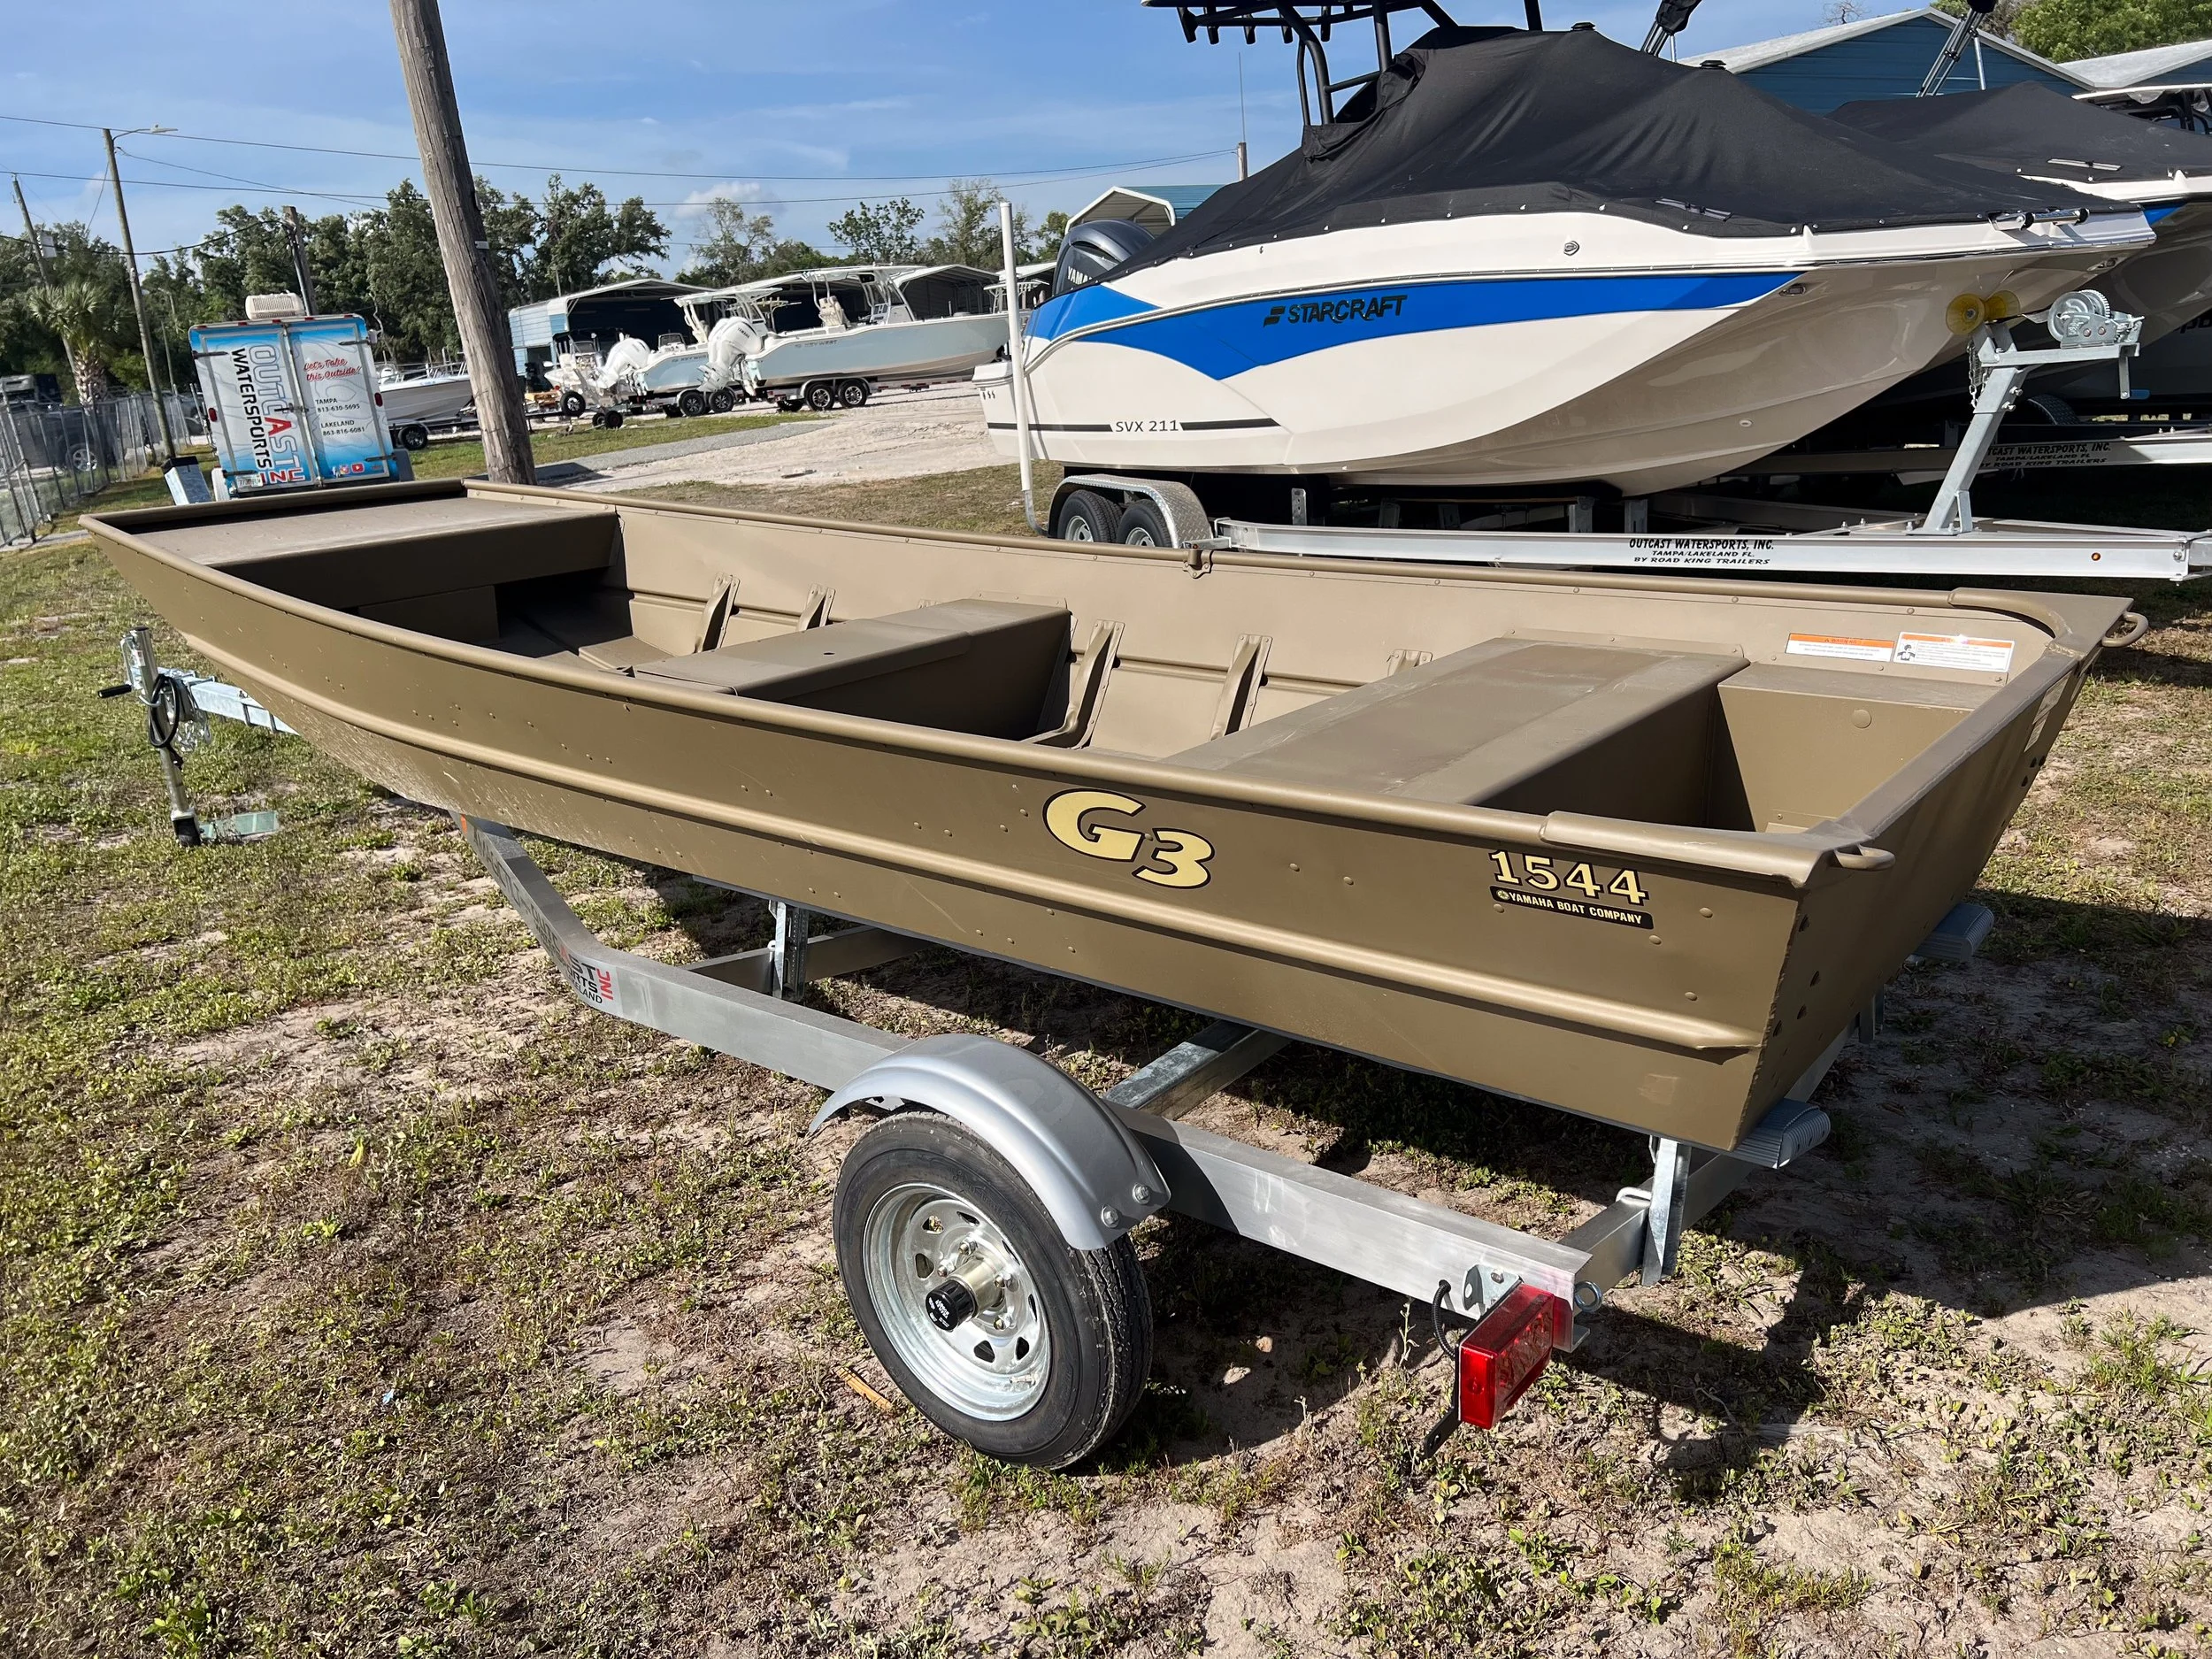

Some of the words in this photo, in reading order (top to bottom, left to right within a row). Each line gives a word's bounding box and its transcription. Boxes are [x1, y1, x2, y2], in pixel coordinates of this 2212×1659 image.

[1067, 265, 1093, 285] YAMA
[1288, 295, 1408, 324] STARCRAFT
[325, 357, 348, 368] Take
[231, 348, 273, 468] WATERSPORTS
[249, 344, 300, 468] OUTCAST
[323, 427, 365, 436] 863-816-6081
[1116, 420, 1144, 433] SVX
[1148, 419, 1179, 432] 211
[1987, 446, 2015, 456] TCAST
[2017, 443, 2088, 455] WATERSPORTS,
[2091, 442, 2111, 451] INC.
[259, 468, 305, 485] INC
[1629, 538, 1672, 549] OUTCAST
[1675, 538, 1749, 550] WATERSPORTS,
[1753, 539, 1774, 550] INC.
[1042, 787, 1215, 889] G3
[1488, 849, 1649, 906] 1544
[1509, 891, 1555, 909] YAMAHA
[1556, 900, 1585, 915] BOAT
[1589, 906, 1642, 925] COMPANY
[596, 968, 614, 1001] INC
